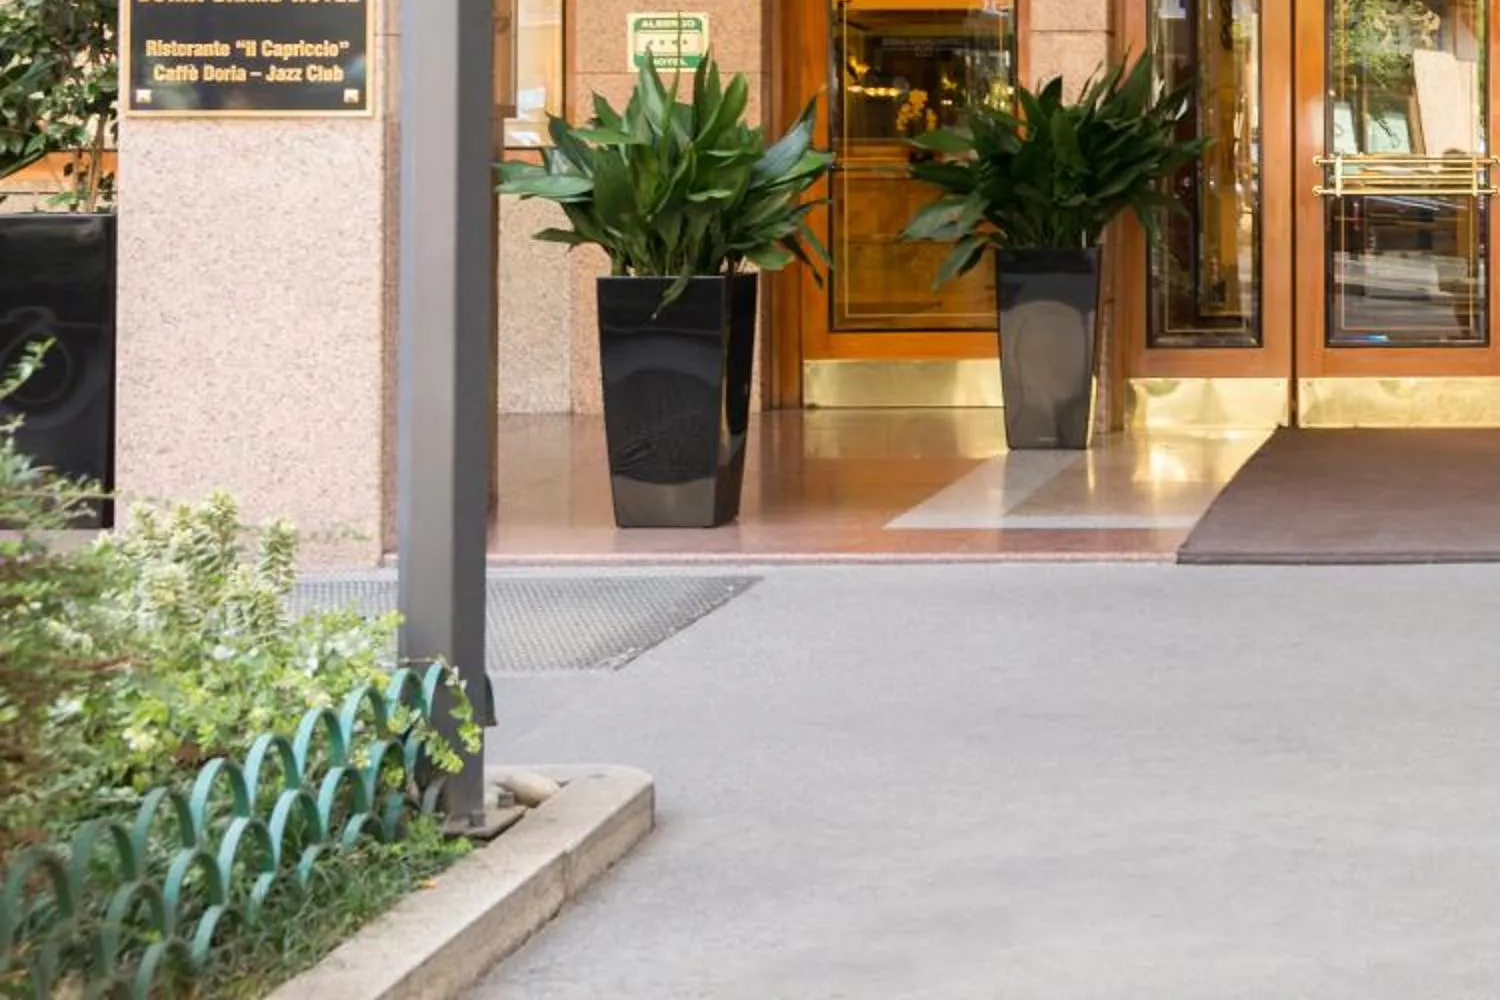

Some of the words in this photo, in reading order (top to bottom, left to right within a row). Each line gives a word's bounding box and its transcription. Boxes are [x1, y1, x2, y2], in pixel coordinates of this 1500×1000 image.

[145, 39, 231, 57] Ristorante
[153, 64, 199, 82] Caffè
[203, 64, 247, 81] Doria
[265, 64, 303, 82] Jazz
[306, 64, 344, 82] Club
